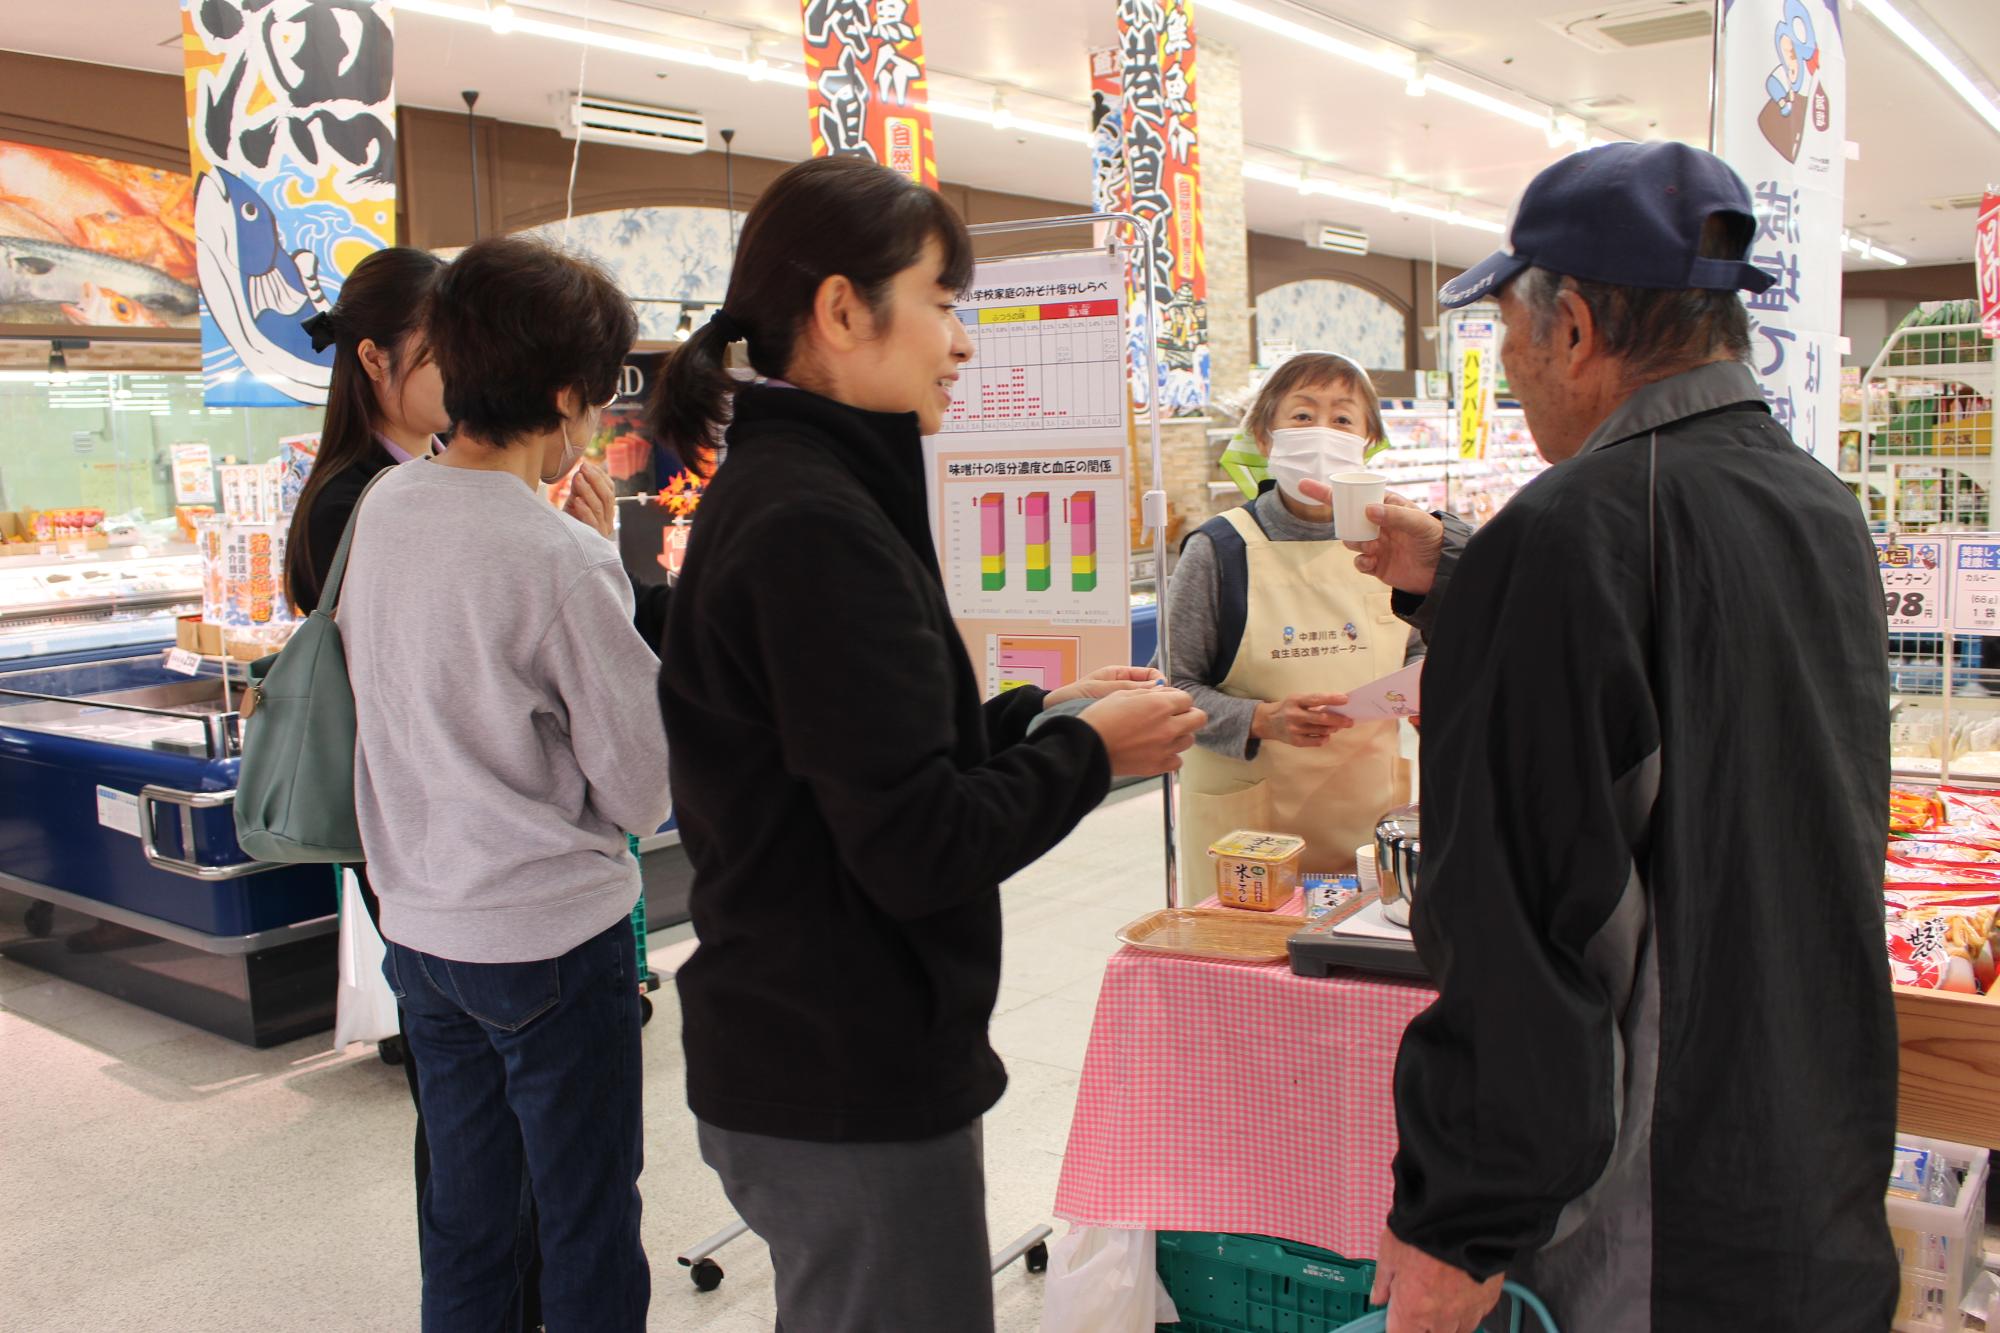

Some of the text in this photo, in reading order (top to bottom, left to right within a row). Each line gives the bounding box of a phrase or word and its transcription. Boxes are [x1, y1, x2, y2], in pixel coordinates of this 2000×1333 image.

[1462, 354, 1480, 455] ハンバーグ
[948, 459, 1112, 477] 味噌汁の塩分濃度と血圧の関係
[1298, 630, 1337, 642] 中津川市
[1271, 644, 1368, 660] 食生活改善サポーター
